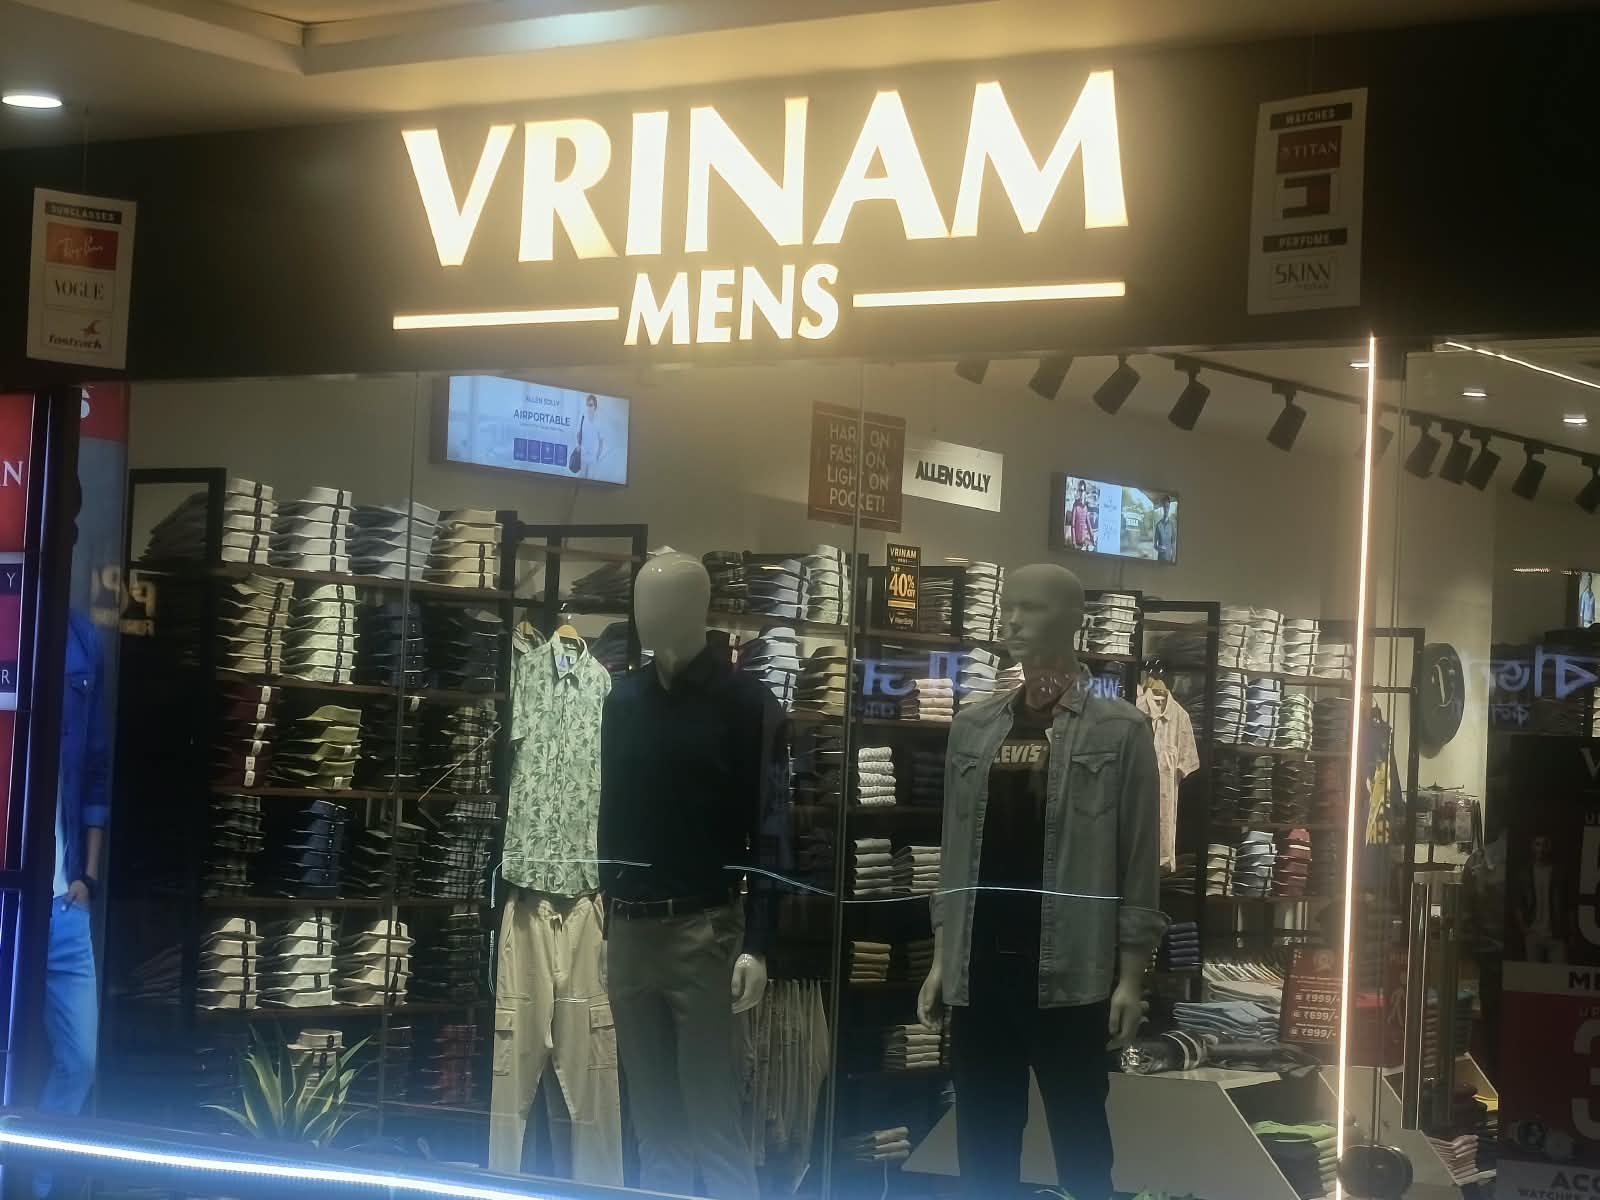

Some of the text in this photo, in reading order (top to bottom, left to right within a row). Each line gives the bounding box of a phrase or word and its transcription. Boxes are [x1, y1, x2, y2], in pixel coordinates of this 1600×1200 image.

[1286, 108, 1336, 125] WATCHES
[1295, 140, 1338, 158] TITAN
[401, 70, 1128, 267] VRINAM
[1279, 233, 1330, 248] PERFUME
[1275, 263, 1330, 284] SKINN
[55, 279, 104, 301] VOGUE
[624, 263, 838, 346] MENS
[513, 409, 571, 427] AIRPORTABLE
[830, 423, 889, 449] HAR ON
[829, 443, 887, 469] FASHON
[868, 473, 889, 491] ON
[915, 460, 992, 493] ALLEN SOLLY
[890, 547, 917, 559] VRINAM
